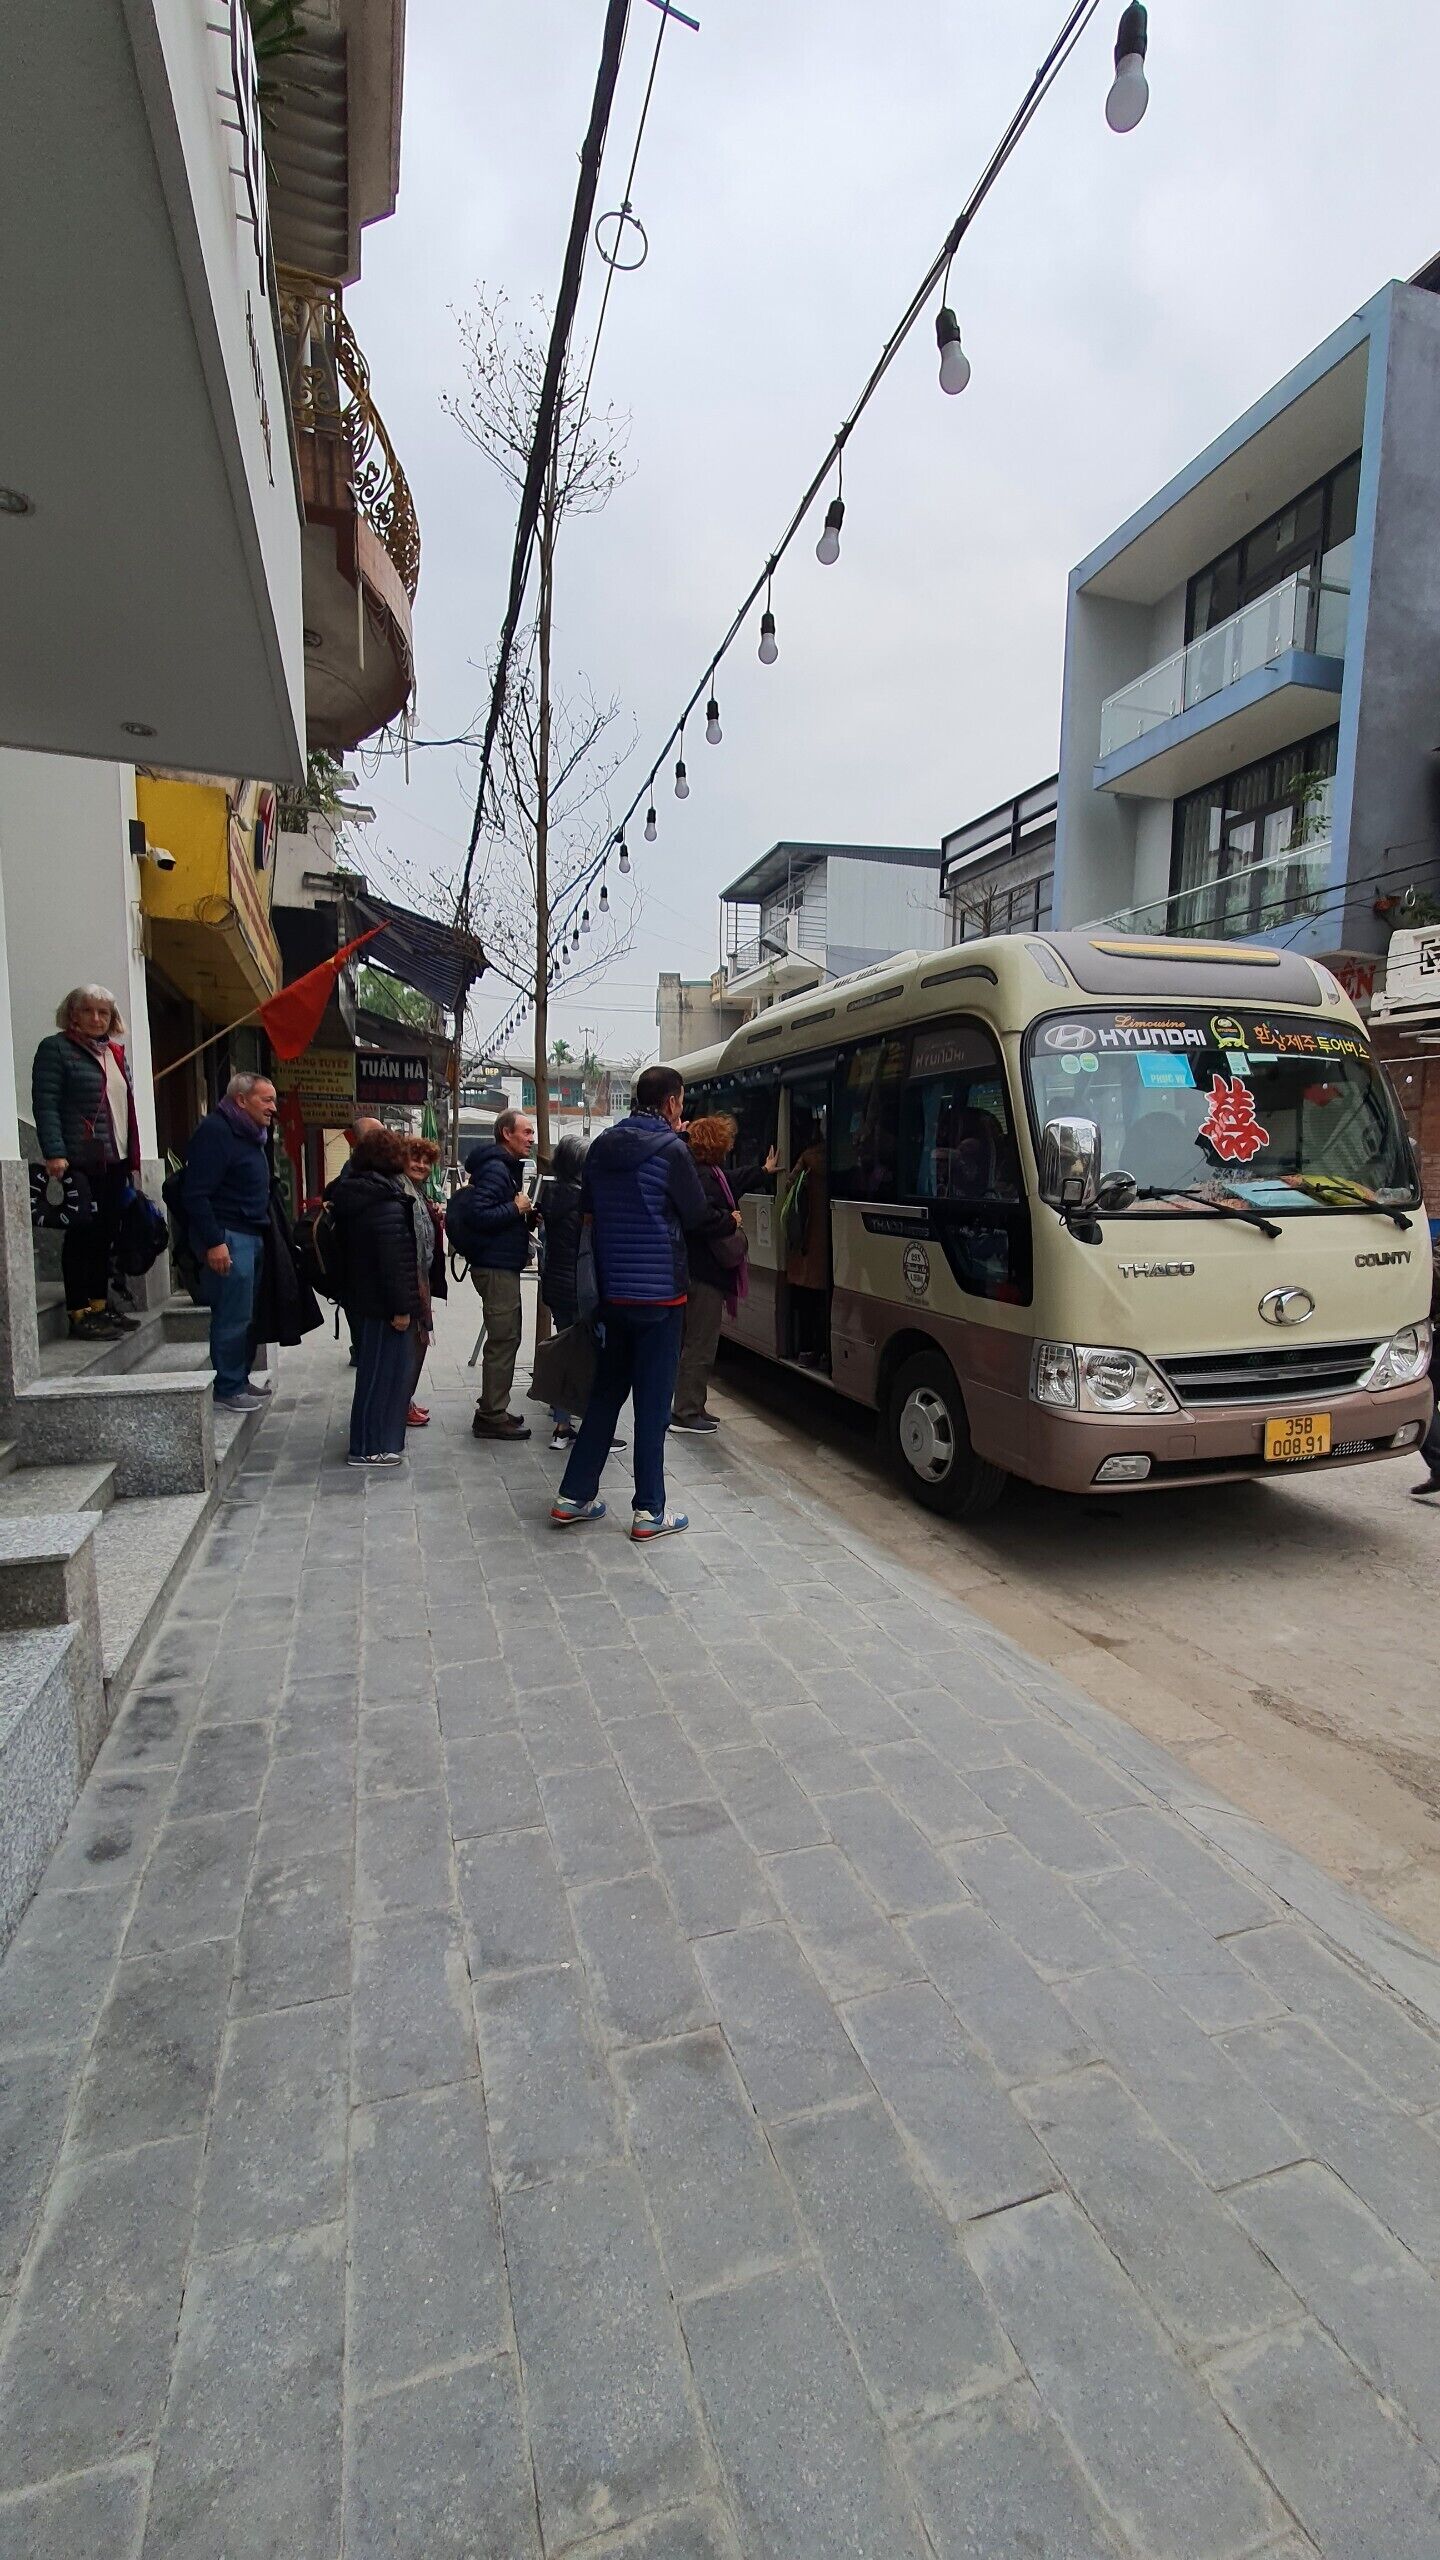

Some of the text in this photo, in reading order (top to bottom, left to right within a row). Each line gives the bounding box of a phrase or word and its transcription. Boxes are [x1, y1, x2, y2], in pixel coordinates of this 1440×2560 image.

[1114, 1015, 1186, 1028] Limousine
[1100, 1029, 1207, 1046] HYUNDAI
[1316, 1037, 1370, 1059] 투어버스
[360, 1055, 424, 1079] TUẤN HÀ
[1354, 1250, 1412, 1268] COUNTY
[1117, 1261, 1195, 1278] THACO
[1284, 1415, 1313, 1437] 35B
[1272, 1436, 1325, 1457] 008.91
